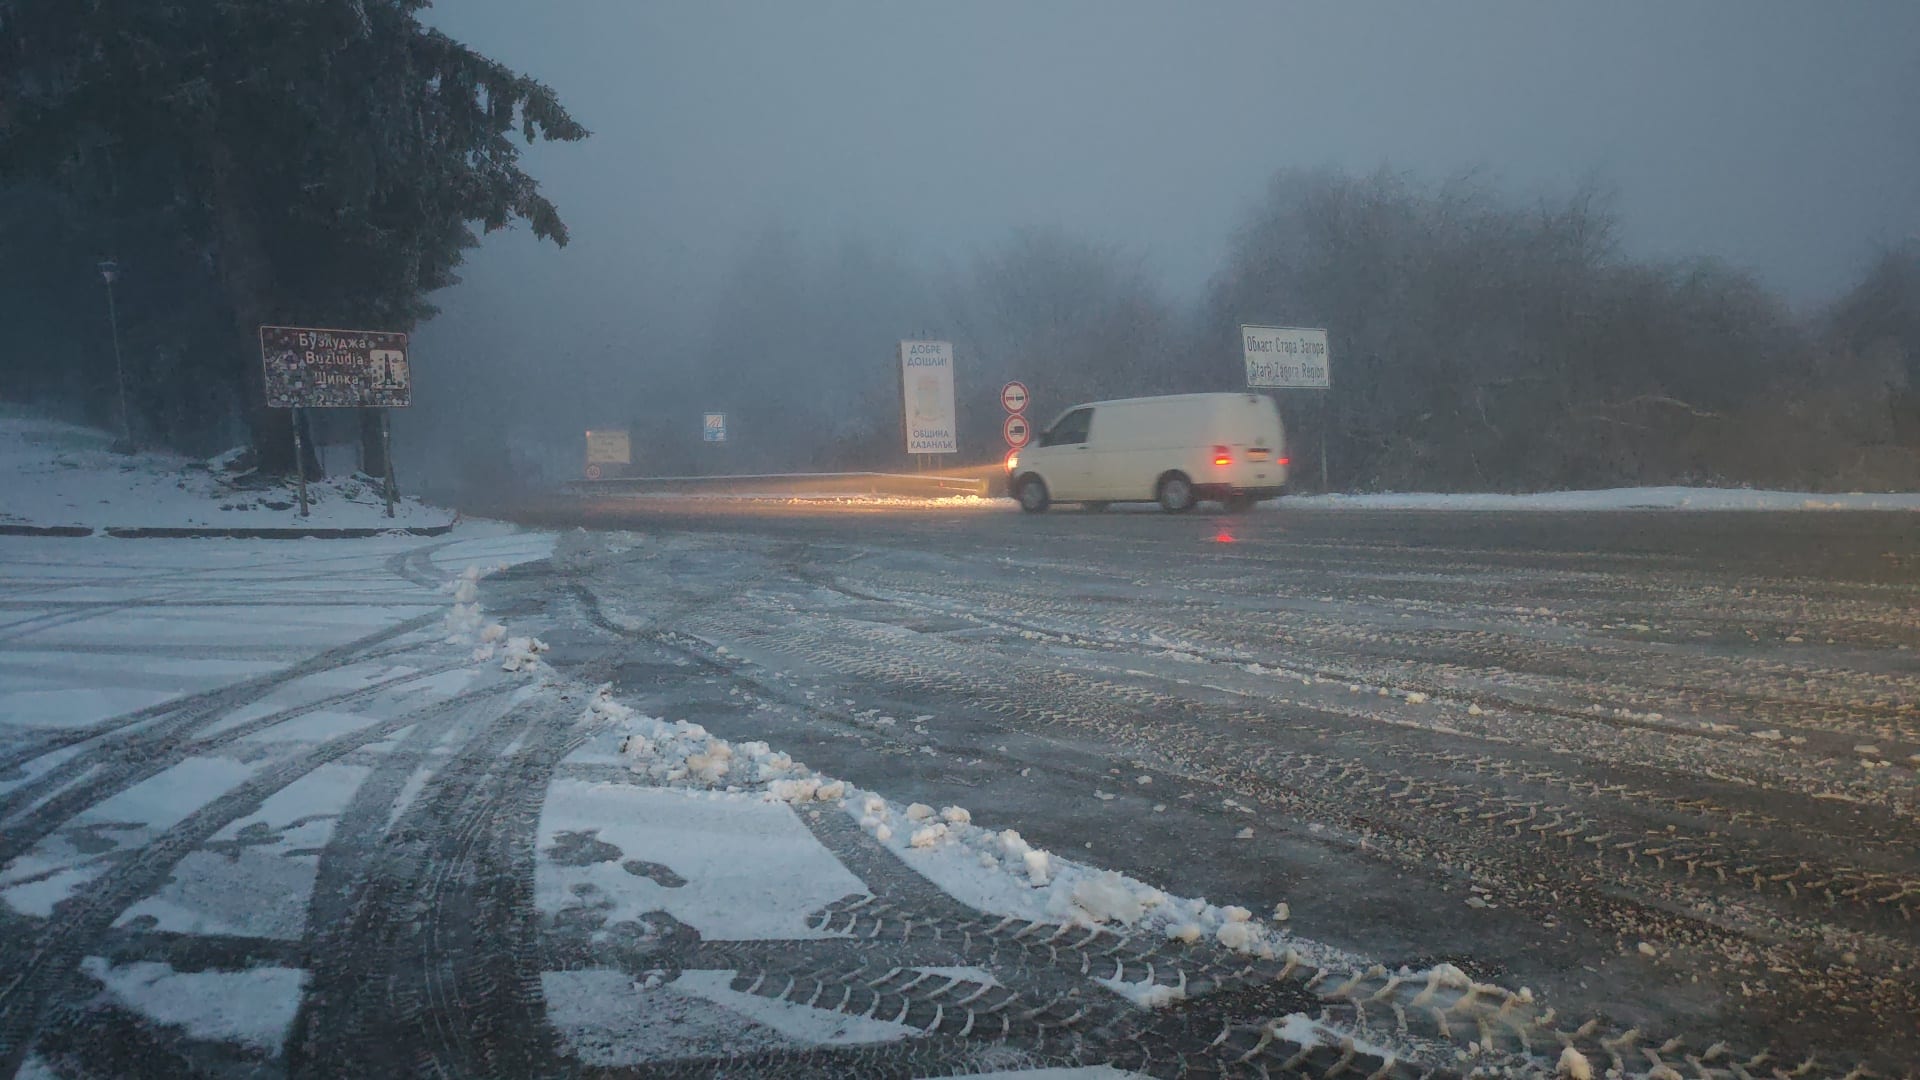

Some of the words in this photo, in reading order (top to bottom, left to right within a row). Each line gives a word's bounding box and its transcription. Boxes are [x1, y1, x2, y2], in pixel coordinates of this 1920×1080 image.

[299, 333, 366, 350] Бузлуджа
[1247, 335, 1273, 352] Област
[1276, 337, 1297, 357] Стара
[1299, 338, 1324, 358] Загора
[911, 344, 942, 354] ДОБРЕ
[305, 351, 364, 367] Buzludja
[907, 357, 947, 368] ДОШЛИ!
[1251, 361, 1272, 377] Stara
[1274, 362, 1298, 382] Zagora
[1301, 363, 1325, 382] Region
[913, 429, 949, 439] ОБЩИНА
[911, 440, 952, 449] КАЗАНЛЪК
